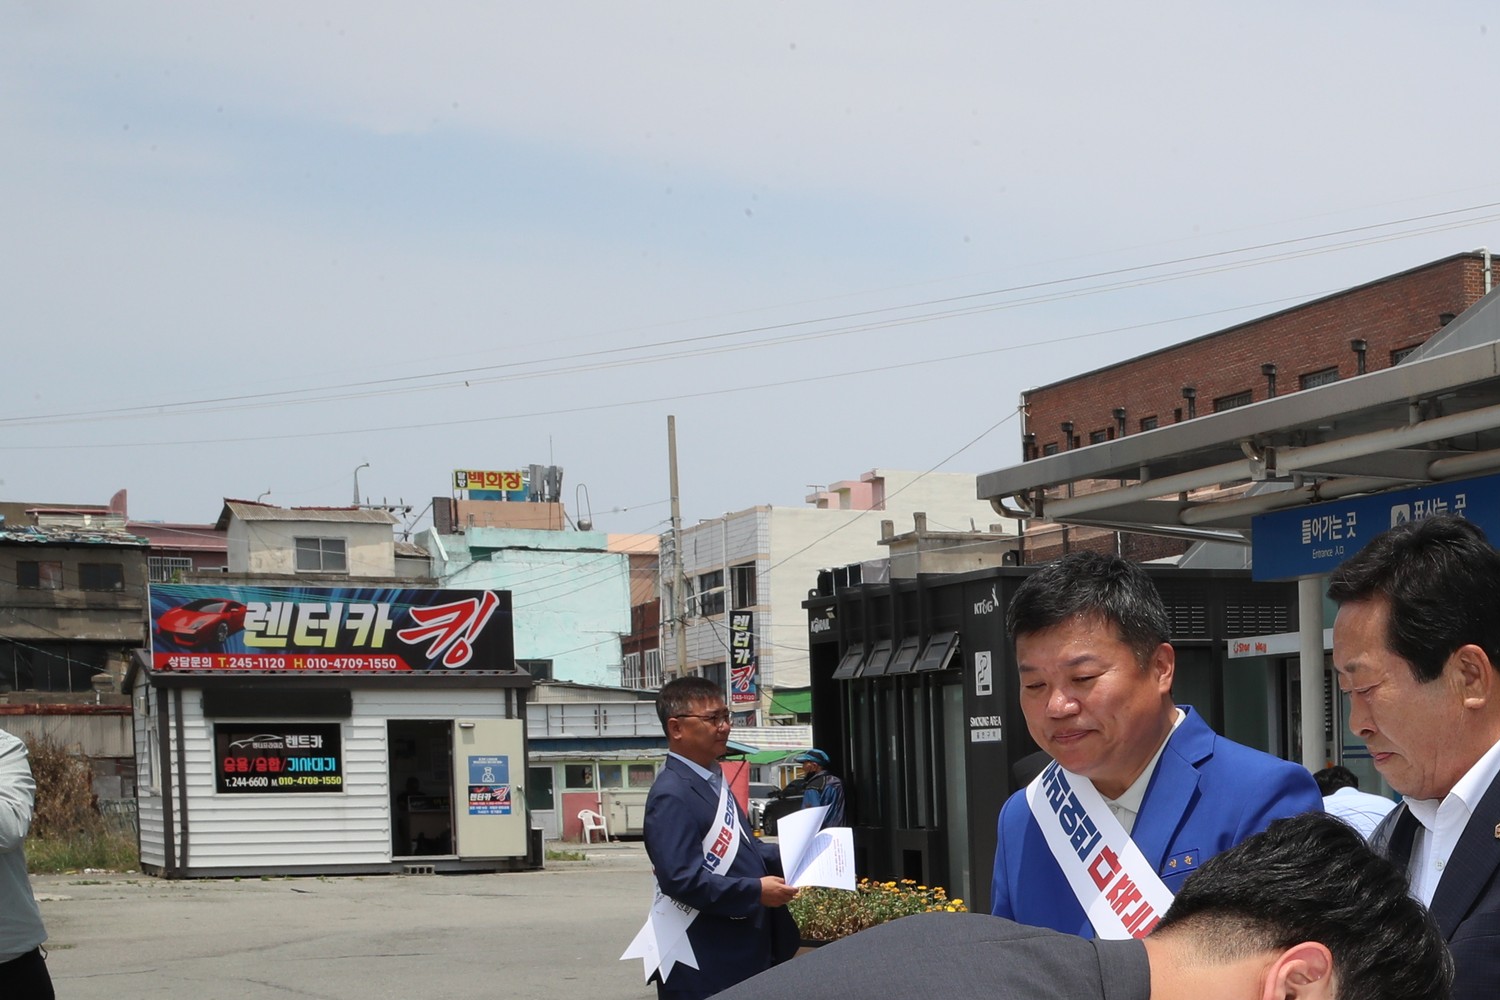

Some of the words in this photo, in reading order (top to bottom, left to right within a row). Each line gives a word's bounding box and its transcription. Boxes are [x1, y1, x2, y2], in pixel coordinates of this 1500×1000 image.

[467, 471, 522, 490] 백화장
[1413, 493, 1448, 522] 표사는
[1302, 513, 1342, 545] 들어가는
[1346, 511, 1357, 539] 곳
[1312, 548, 1334, 559] Entrance
[974, 598, 994, 615] KT&G
[243, 601, 394, 648] 렌터카
[397, 590, 500, 668] 킹
[732, 615, 751, 665] 렌터카
[168, 656, 212, 668] 상담문의
[218, 657, 286, 669] T.245-1120
[294, 657, 397, 669] H.010-4709-1550
[970, 716, 990, 727] SMOKING
[990, 715, 1002, 726] AREA
[285, 735, 323, 749] 렌트카
[1087, 845, 1122, 892] 다
[1105, 873, 1162, 939] 죽는
